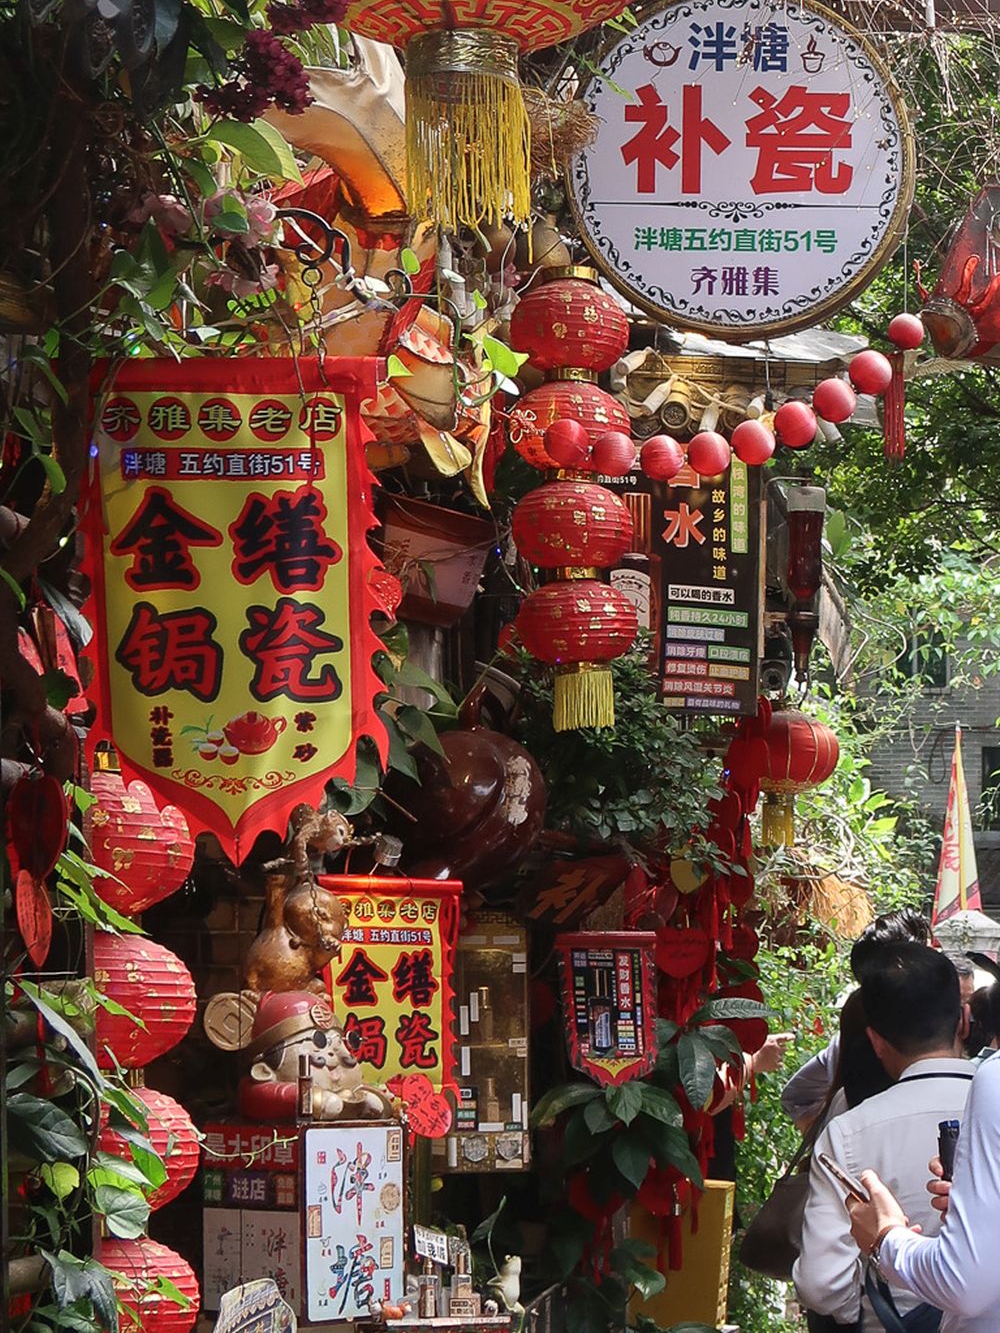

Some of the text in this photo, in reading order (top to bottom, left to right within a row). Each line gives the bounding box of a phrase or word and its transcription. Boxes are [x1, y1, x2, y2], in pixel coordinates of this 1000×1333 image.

[688, 22, 789, 73] 泮塘
[620, 84, 853, 195] 补瓷
[633, 227, 838, 254] 泮塘五约直街51号
[690, 266, 780, 296] 齐雅集
[101, 403, 342, 435] 齐雅集老店
[125, 453, 321, 477] 泮塘 五约直街51号
[112, 487, 341, 592] 金缮
[711, 489, 727, 580] 故乡的味道
[117, 598, 342, 702] 锔瓷
[370, 930, 432, 943] 五约直街51号
[336, 948, 439, 1008] 金缮
